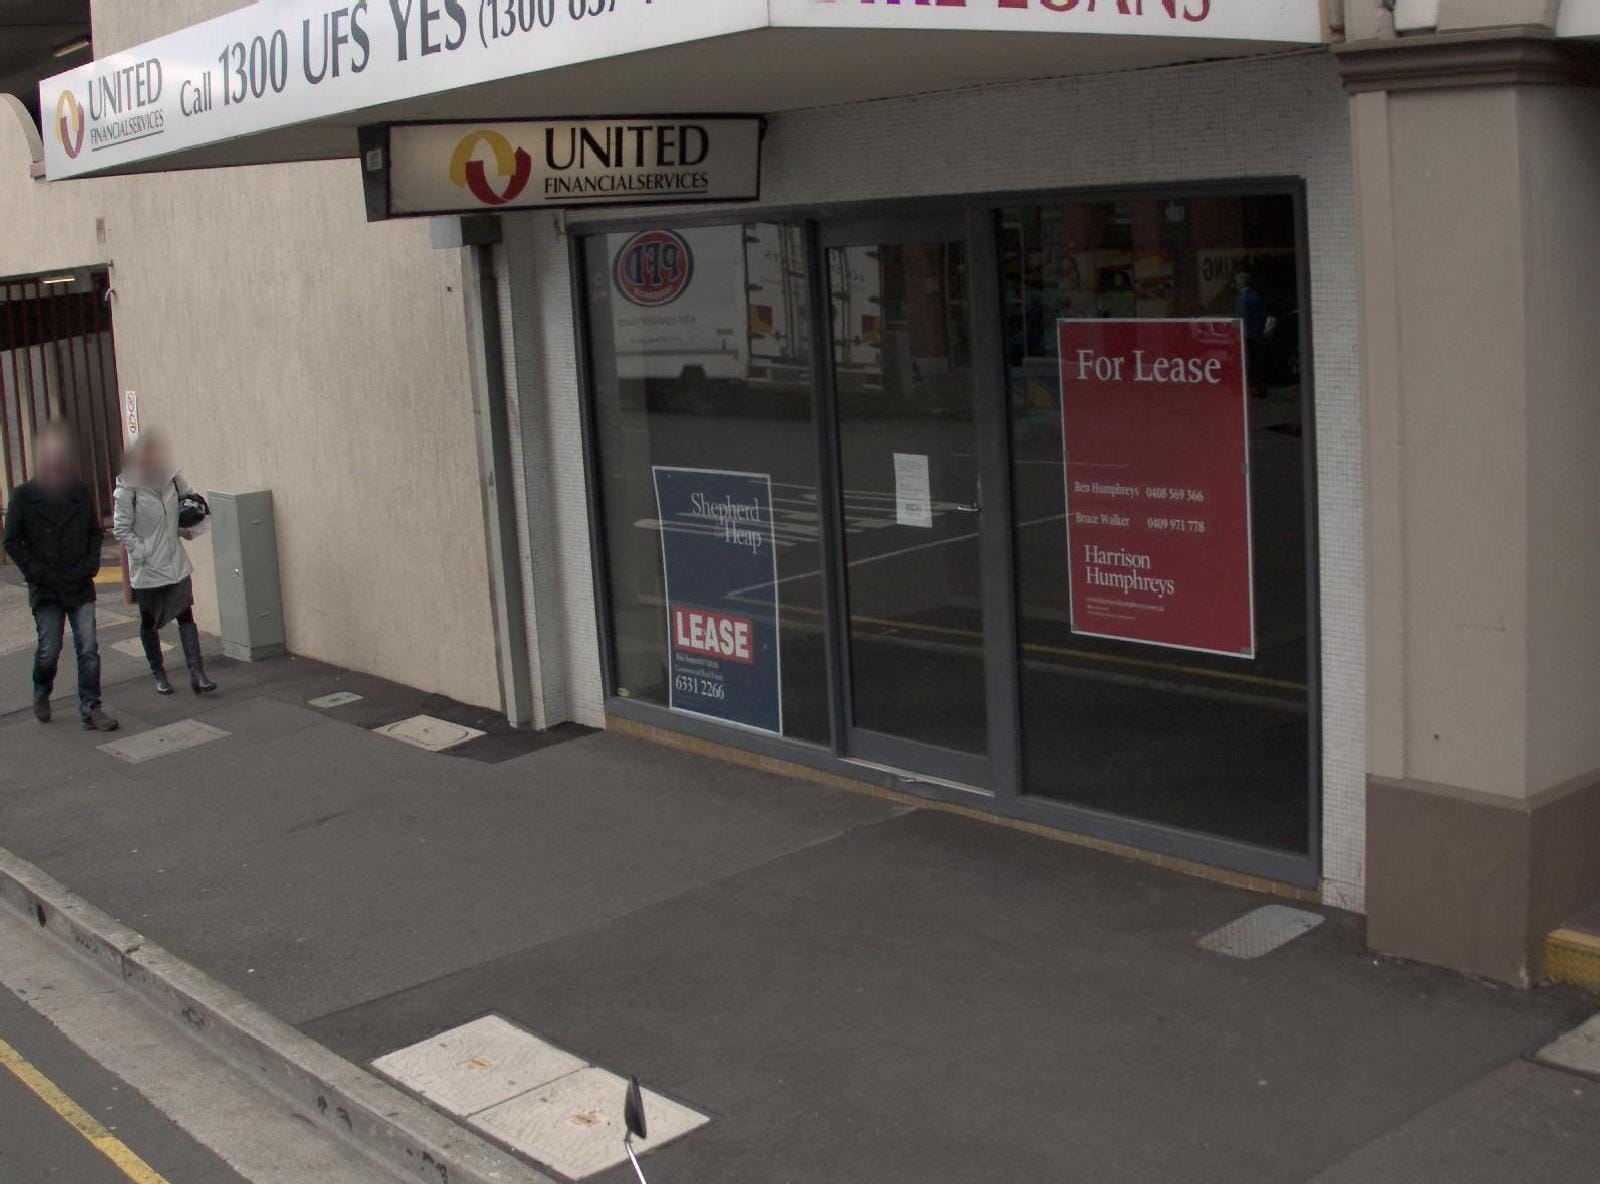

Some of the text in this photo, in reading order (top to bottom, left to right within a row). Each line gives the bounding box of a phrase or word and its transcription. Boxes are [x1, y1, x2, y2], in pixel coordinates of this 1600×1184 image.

[180, 71, 212, 117] Call
[218, 29, 288, 106] 1300
[302, 0, 370, 85] UFS
[388, 0, 467, 62] YES
[88, 58, 163, 121] UNITED
[545, 124, 710, 171] UNITED
[544, 171, 709, 194] FINANCIALSERVICES
[1076, 349, 1222, 384] For Lease
[1074, 481, 1090, 493] Ben
[1092, 482, 1140, 499] Humphreys
[690, 492, 760, 526] Shepherd
[1075, 512, 1100, 525] Bruce
[1100, 513, 1131, 527] Walker
[1170, 519, 1186, 532] 971
[1187, 521, 1206, 533] 778
[724, 520, 763, 555] Heap
[1084, 544, 1151, 570] Harrison
[1086, 566, 1175, 599] Humphreys
[676, 611, 750, 659] LEASE
[675, 675, 725, 700] 6331 2266
